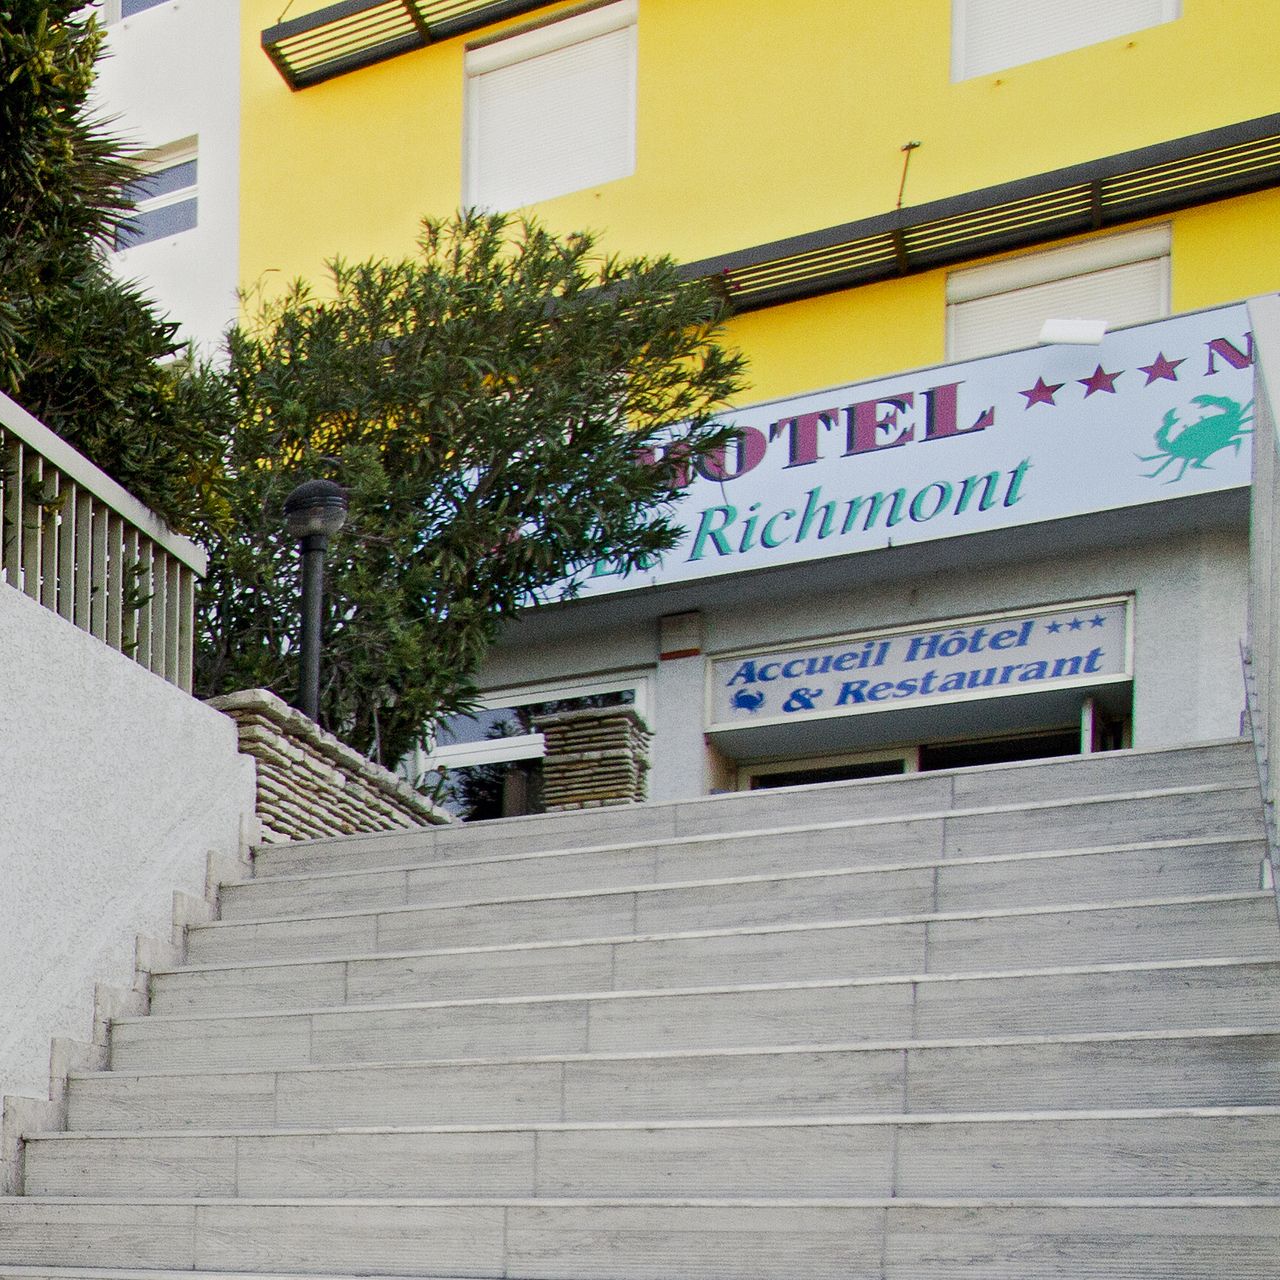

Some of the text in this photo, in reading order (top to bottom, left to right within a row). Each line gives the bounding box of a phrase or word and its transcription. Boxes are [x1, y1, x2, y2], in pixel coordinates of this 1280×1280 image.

[686, 456, 1035, 563] Richmont
[727, 620, 1035, 687] Accueil Hôtel
[782, 647, 1107, 714] & Restaurant
